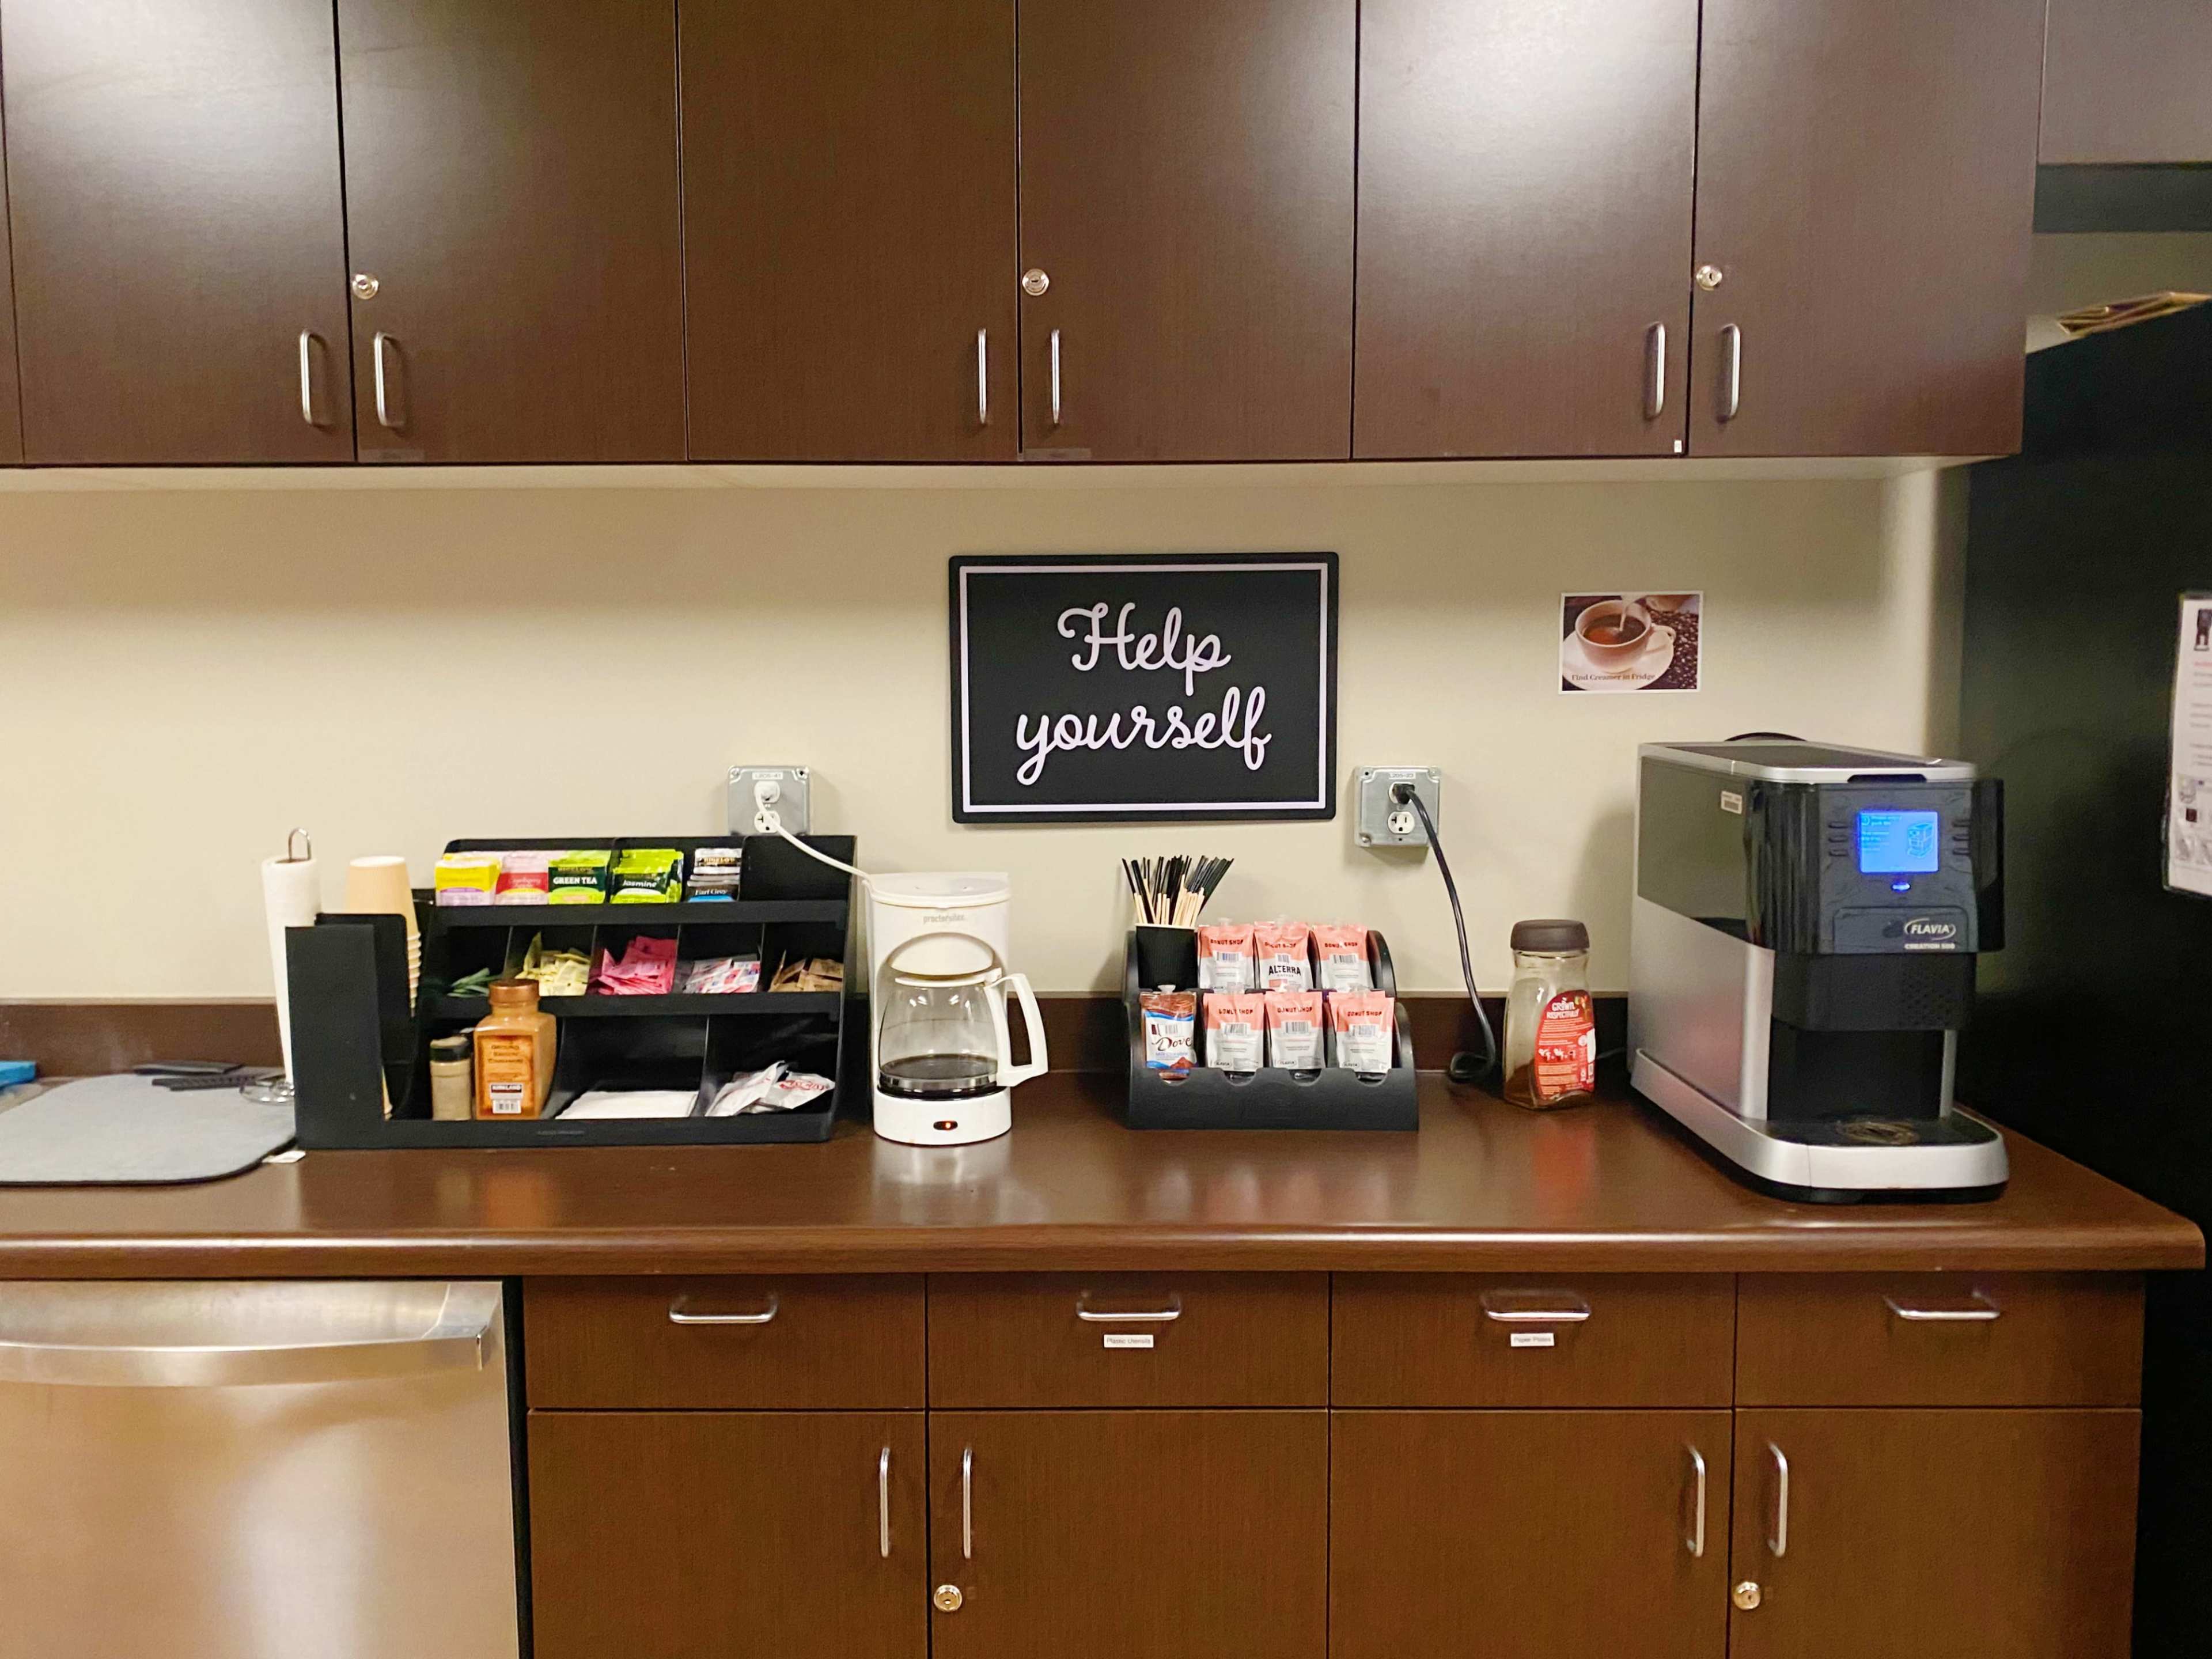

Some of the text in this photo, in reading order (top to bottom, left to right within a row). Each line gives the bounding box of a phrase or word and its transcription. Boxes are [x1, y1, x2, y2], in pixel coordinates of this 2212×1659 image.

[1057, 602, 1232, 696] Help
[1016, 686, 1272, 785] yourself
[623, 880, 657, 888] Jasmine
[1911, 924, 1950, 934] FLAVIA
[1268, 965, 1301, 976] ALTERRA
